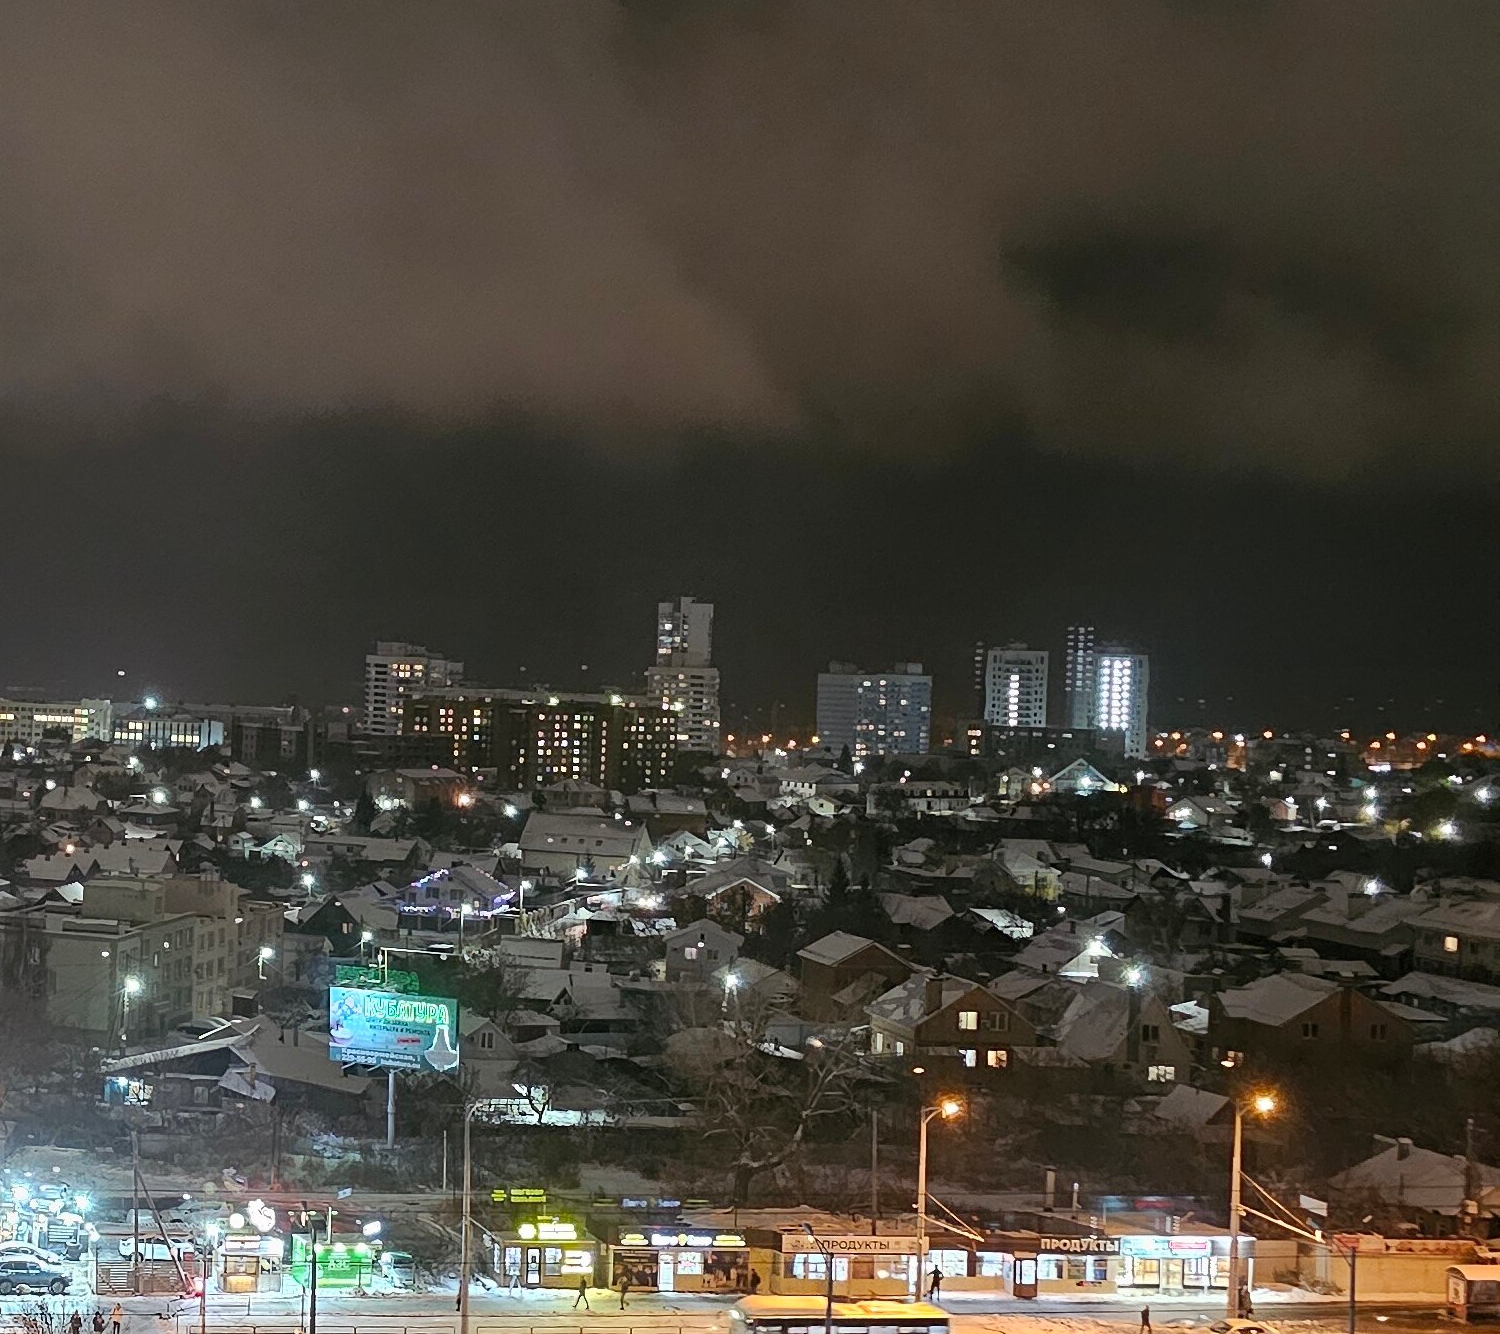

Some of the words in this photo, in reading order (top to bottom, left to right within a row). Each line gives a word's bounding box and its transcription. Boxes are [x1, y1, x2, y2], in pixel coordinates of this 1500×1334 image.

[363, 996, 450, 1025] КУБАТУРА
[822, 1240, 890, 1250] ПРОДУКТЫ
[1040, 1238, 1119, 1252] ПРОДУКТЫ
